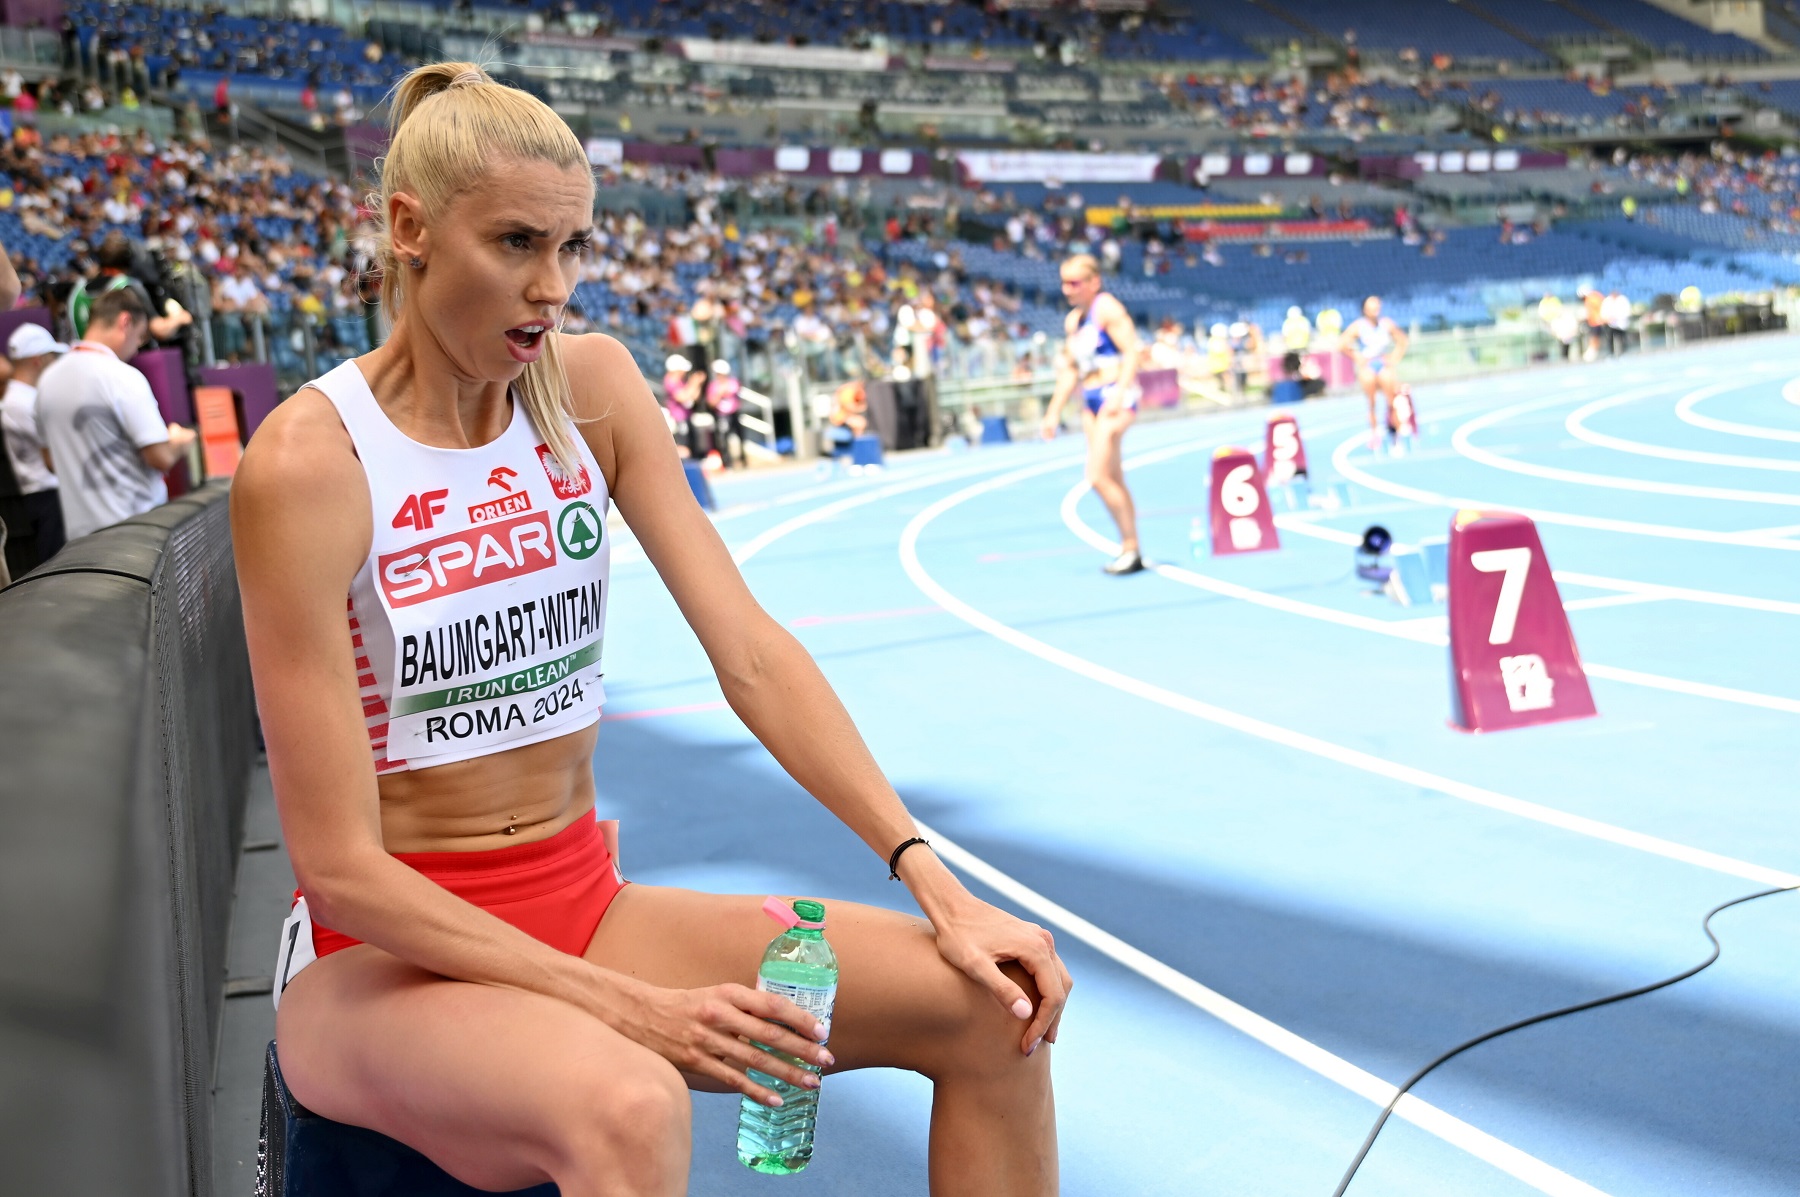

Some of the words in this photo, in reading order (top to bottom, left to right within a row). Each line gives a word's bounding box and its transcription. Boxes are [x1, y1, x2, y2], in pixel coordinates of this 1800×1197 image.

[1272, 422, 1299, 461] 5
[391, 488, 449, 532] 4F
[472, 495, 528, 523] ORLEN
[1220, 463, 1260, 517] 6
[384, 521, 552, 600] SPAR
[1470, 546, 1532, 645] 7
[400, 579, 602, 688] BAUMGART-WITAN
[426, 703, 527, 743] ROMA
[532, 678, 584, 723] 2024
[445, 690, 453, 705] I
[457, 679, 507, 702] RUN
